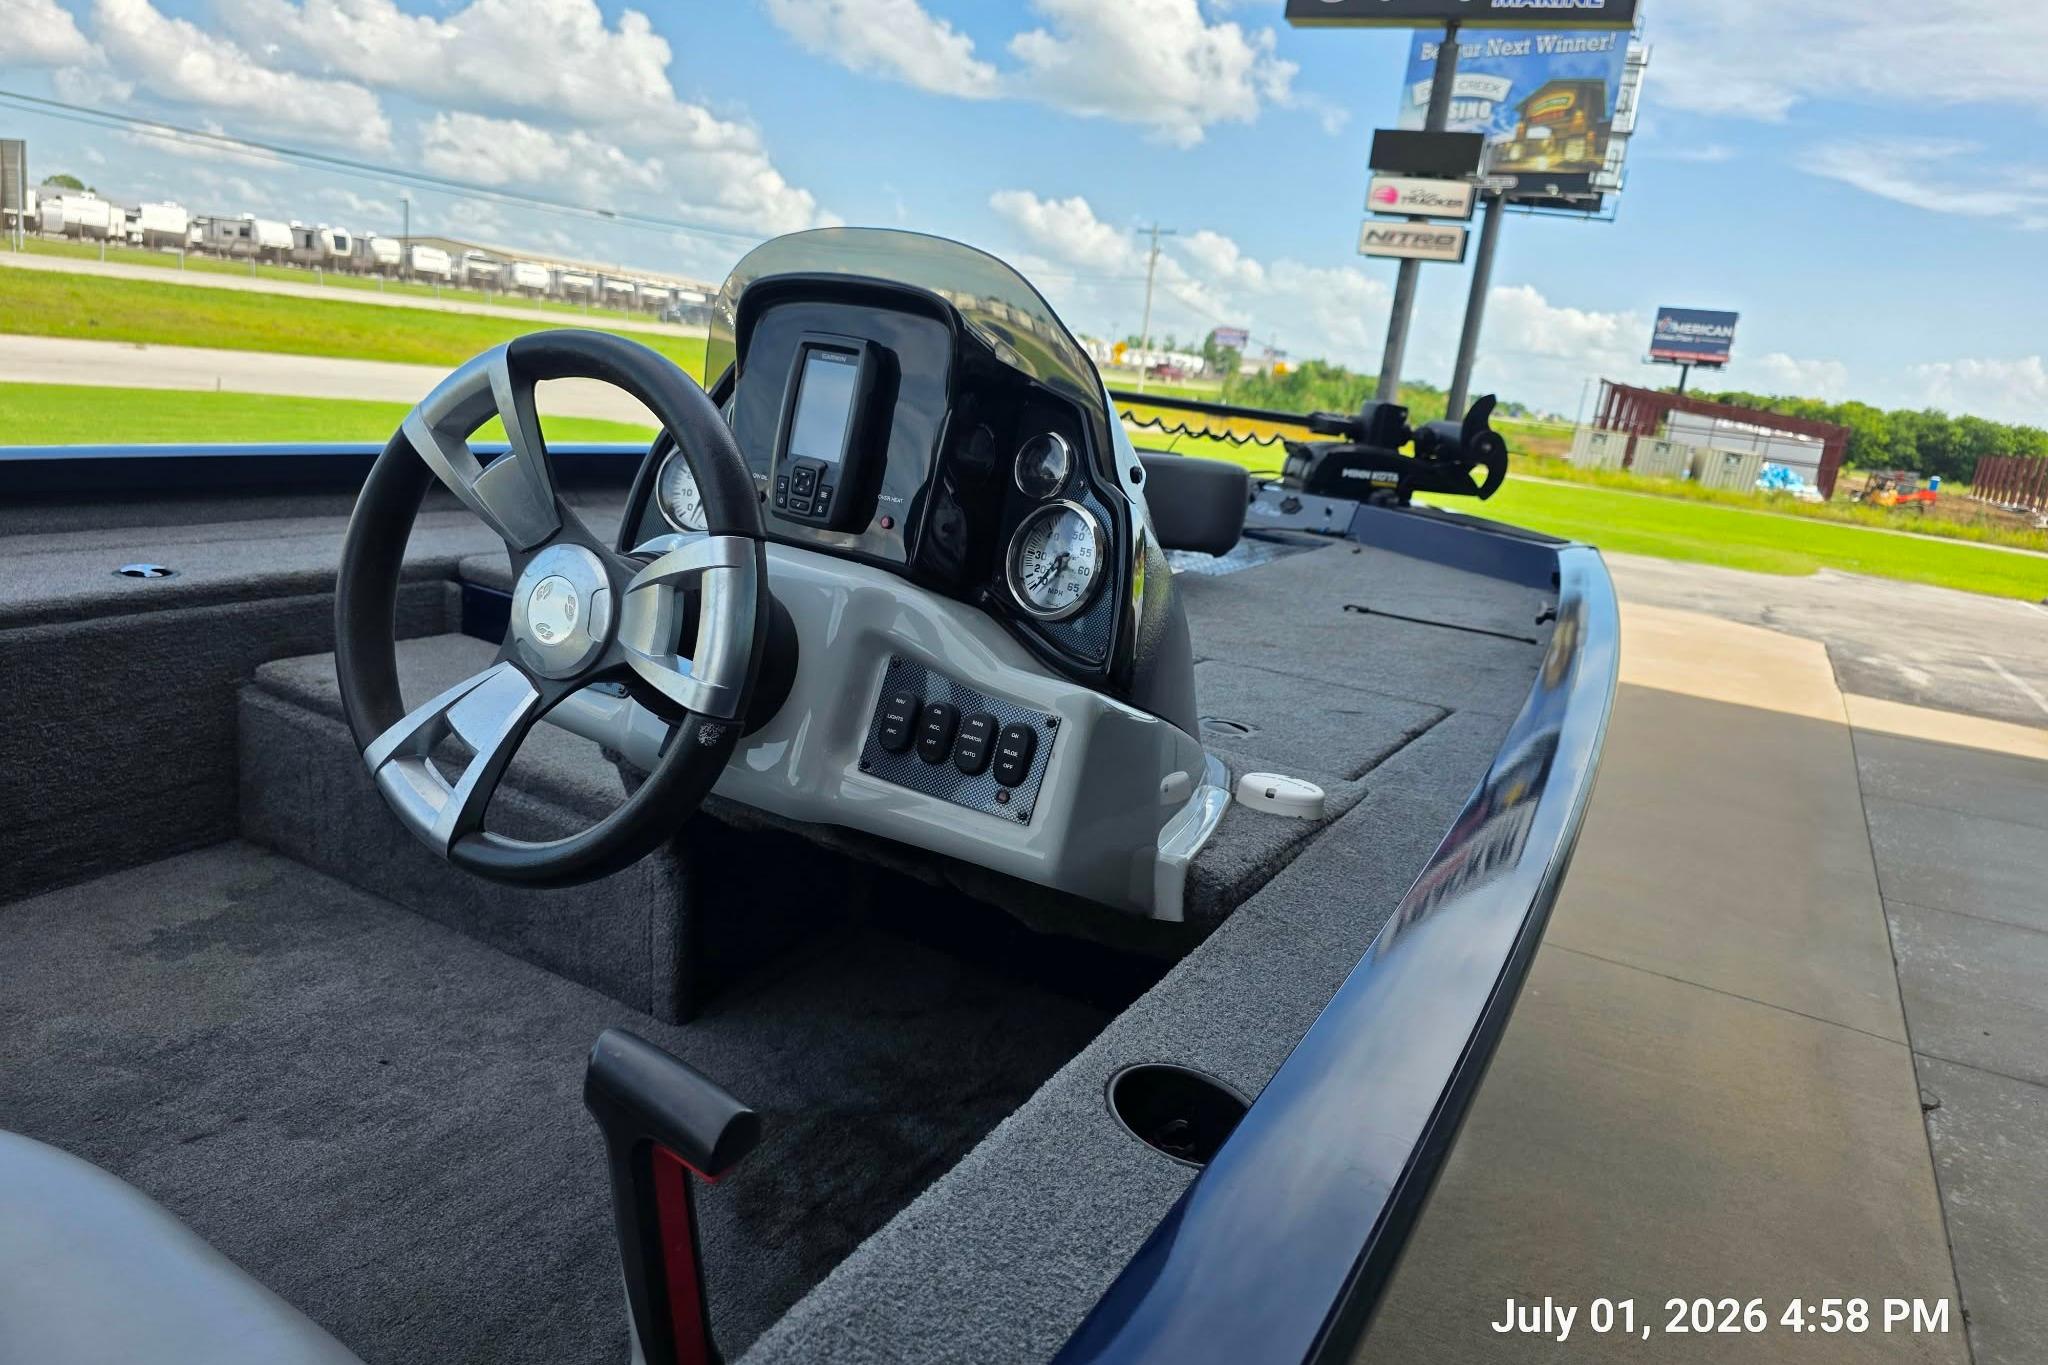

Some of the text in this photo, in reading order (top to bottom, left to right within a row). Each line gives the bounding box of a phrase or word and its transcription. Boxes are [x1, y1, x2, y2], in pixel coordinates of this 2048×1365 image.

[1487, 36, 1531, 57] Next
[1535, 32, 1616, 54] Winner!
[1366, 229, 1457, 247] NITRO
[1072, 532, 1085, 541] 50
[1035, 550, 1047, 560] 30
[1080, 547, 1092, 557] 55
[1034, 564, 1046, 574] 20
[1078, 566, 1090, 576] 60
[1048, 587, 1063, 597] MPH
[1067, 582, 1079, 592] 65
[962, 750, 976, 758] AUTO
